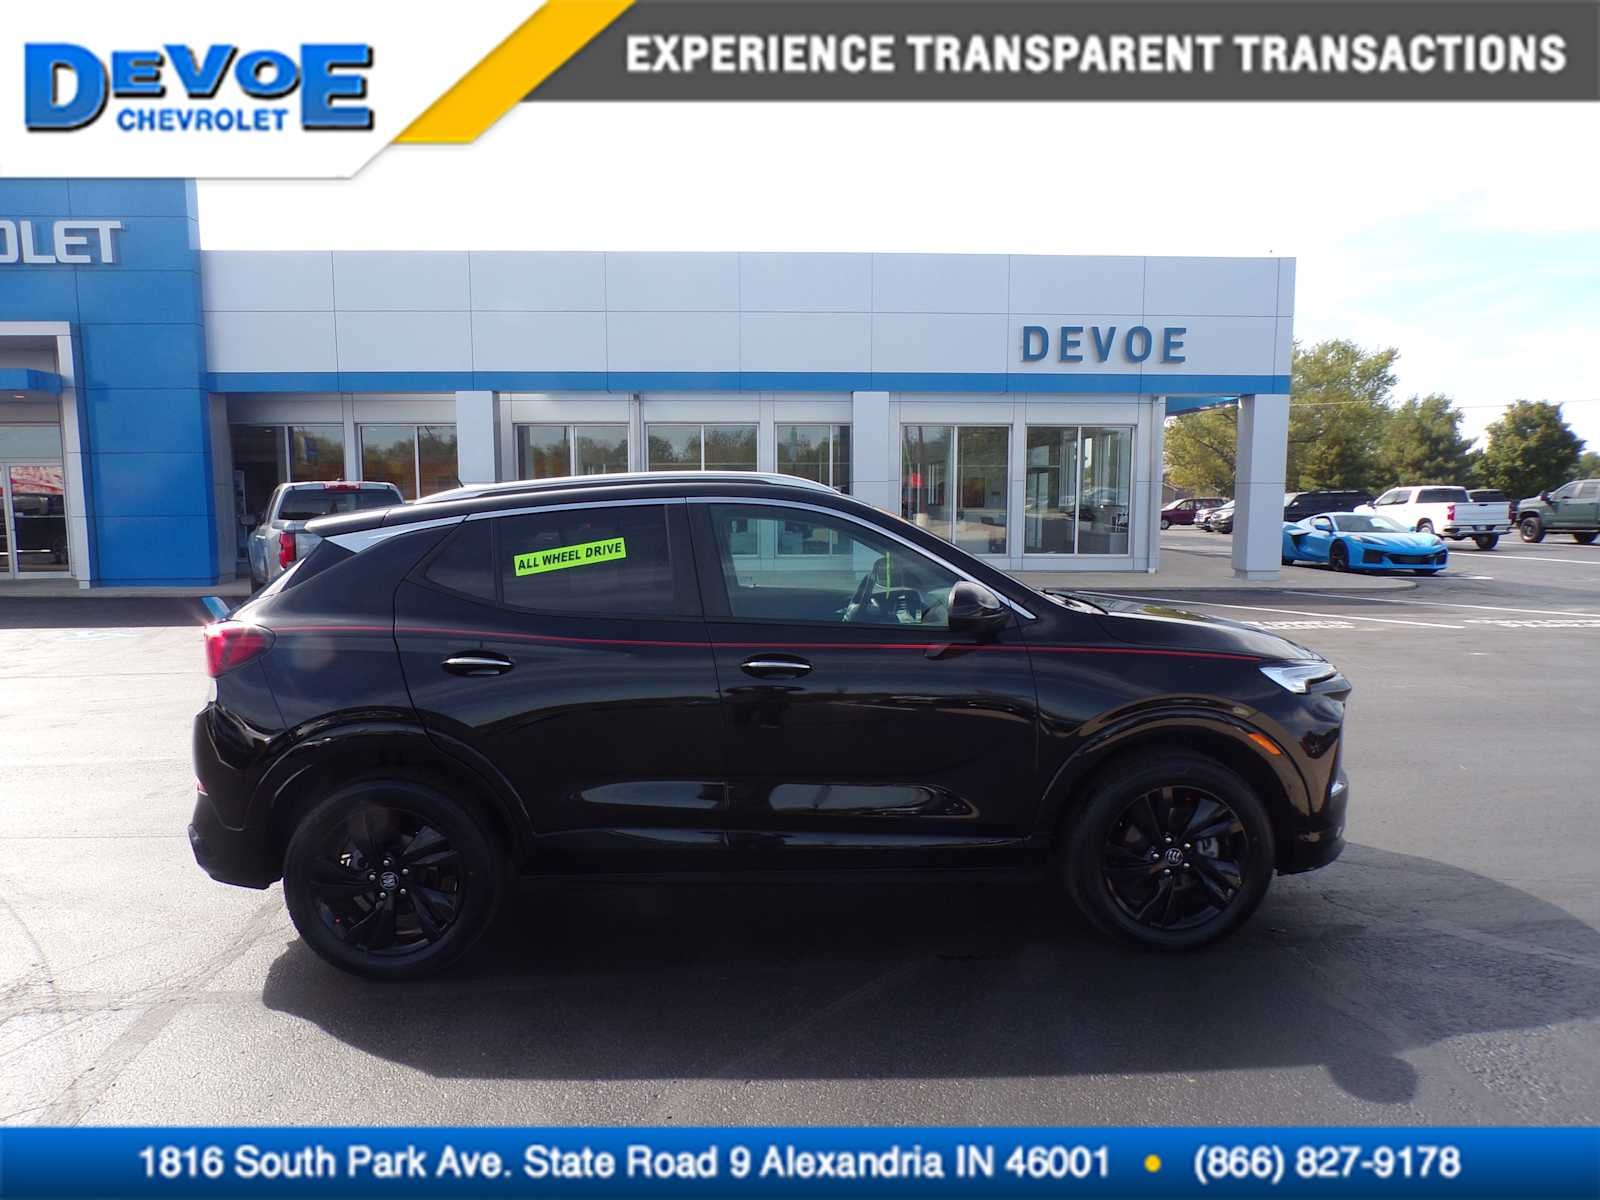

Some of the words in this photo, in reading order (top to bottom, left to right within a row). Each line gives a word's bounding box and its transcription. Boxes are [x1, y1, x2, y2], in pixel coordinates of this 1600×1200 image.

[1022, 326, 1187, 364] DEVOE
[517, 557, 540, 571] ALL
[542, 549, 581, 566] WHEEL
[585, 542, 622, 558] DRIVE
